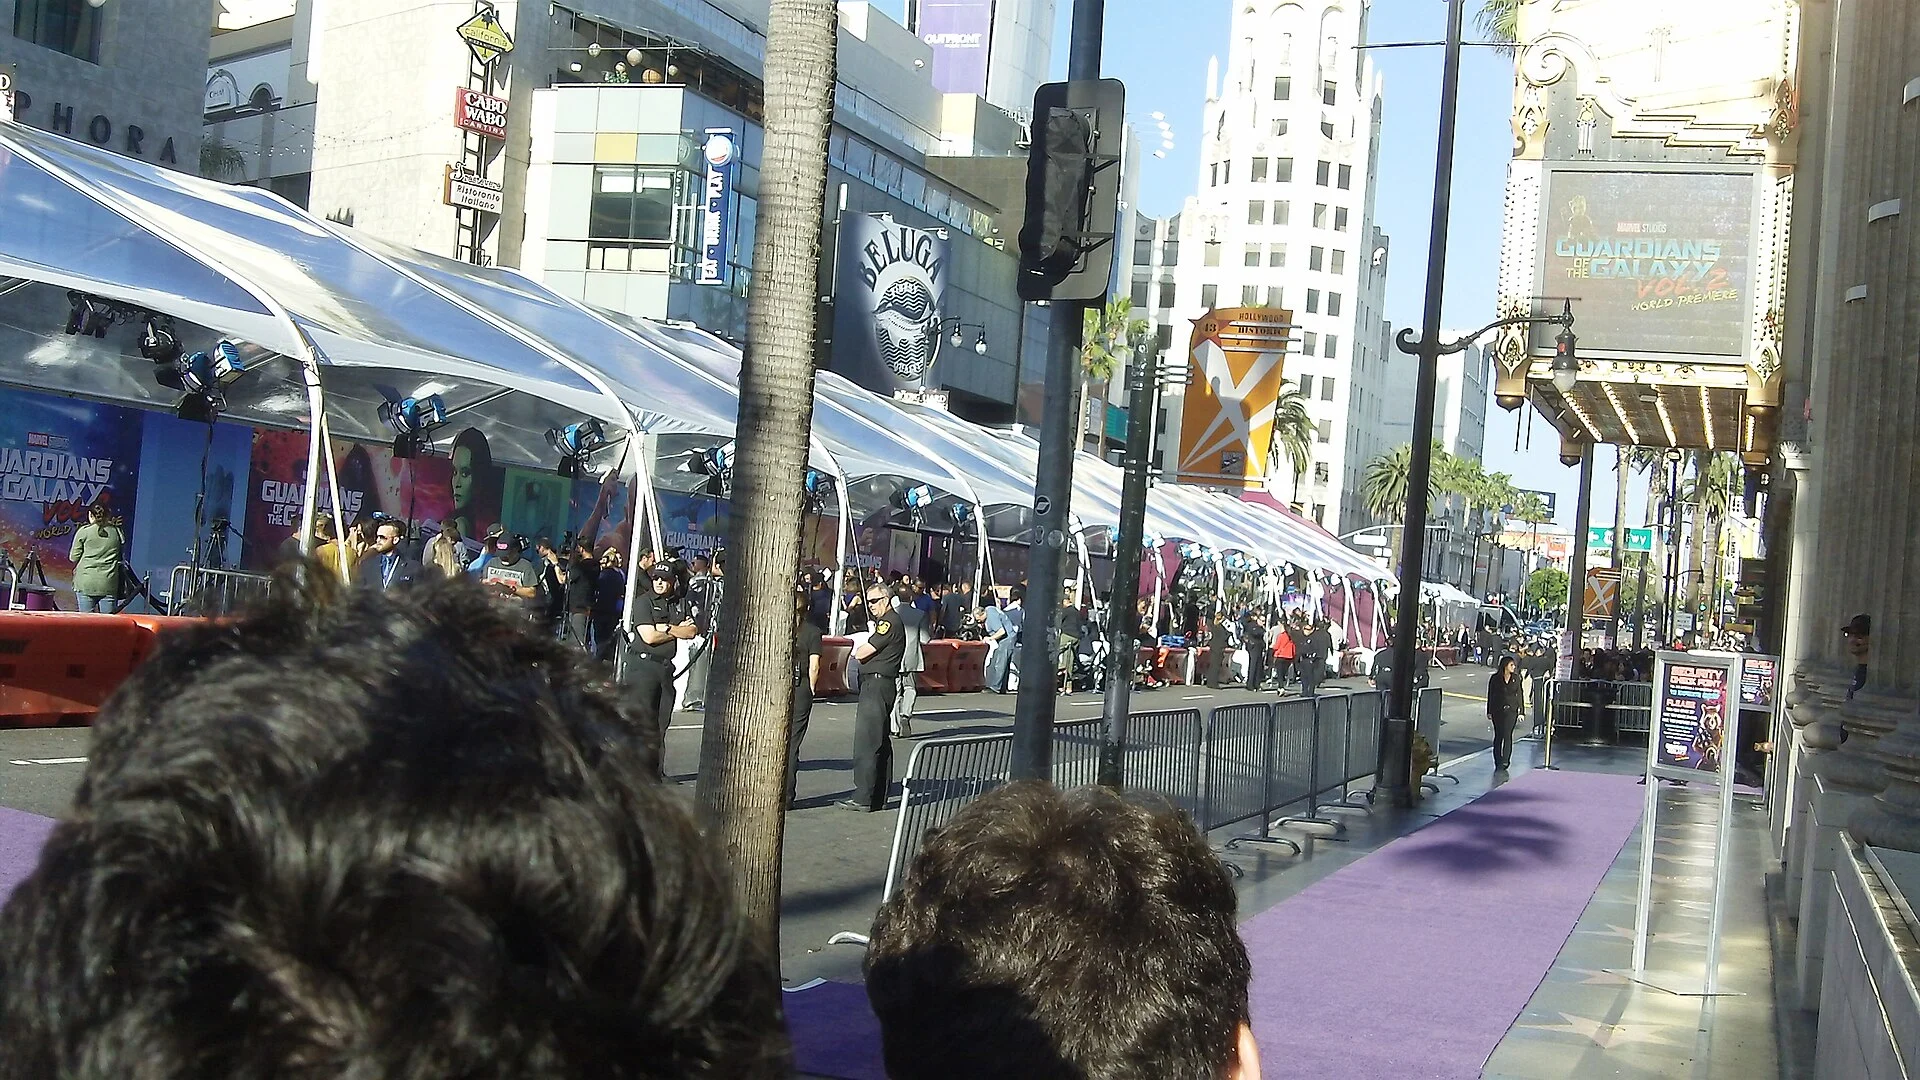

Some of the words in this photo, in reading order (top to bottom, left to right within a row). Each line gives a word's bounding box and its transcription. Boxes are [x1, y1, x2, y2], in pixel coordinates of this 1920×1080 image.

[464, 92, 508, 115] CABO
[464, 106, 507, 128] WABO
[464, 119, 505, 136] CANTINA
[707, 171, 723, 198] PLAY
[461, 195, 495, 209] Italiano
[1617, 223, 1640, 233] MARVEL
[1641, 223, 1667, 233] STUDIOS
[1555, 238, 1721, 261] GUARDIANS
[858, 227, 944, 292] BELUGA
[1574, 258, 1590, 268] OF
[1566, 268, 1590, 279] THE
[1590, 258, 1716, 281] GALAXY
[1706, 267, 1729, 290] 2
[1631, 299, 1674, 311] WORLD
[1677, 289, 1738, 308] PREMIERE
[1239, 312, 1284, 323] HOLLYWOOD
[1204, 323, 1217, 332] 13
[2, 474, 105, 507] GALAXY
[273, 504, 284, 514] OF
[268, 513, 283, 525] THE
[36, 525, 71, 540] WORLD
[1671, 666, 1723, 680] SECURITY
[1670, 676, 1697, 686] CHECK
